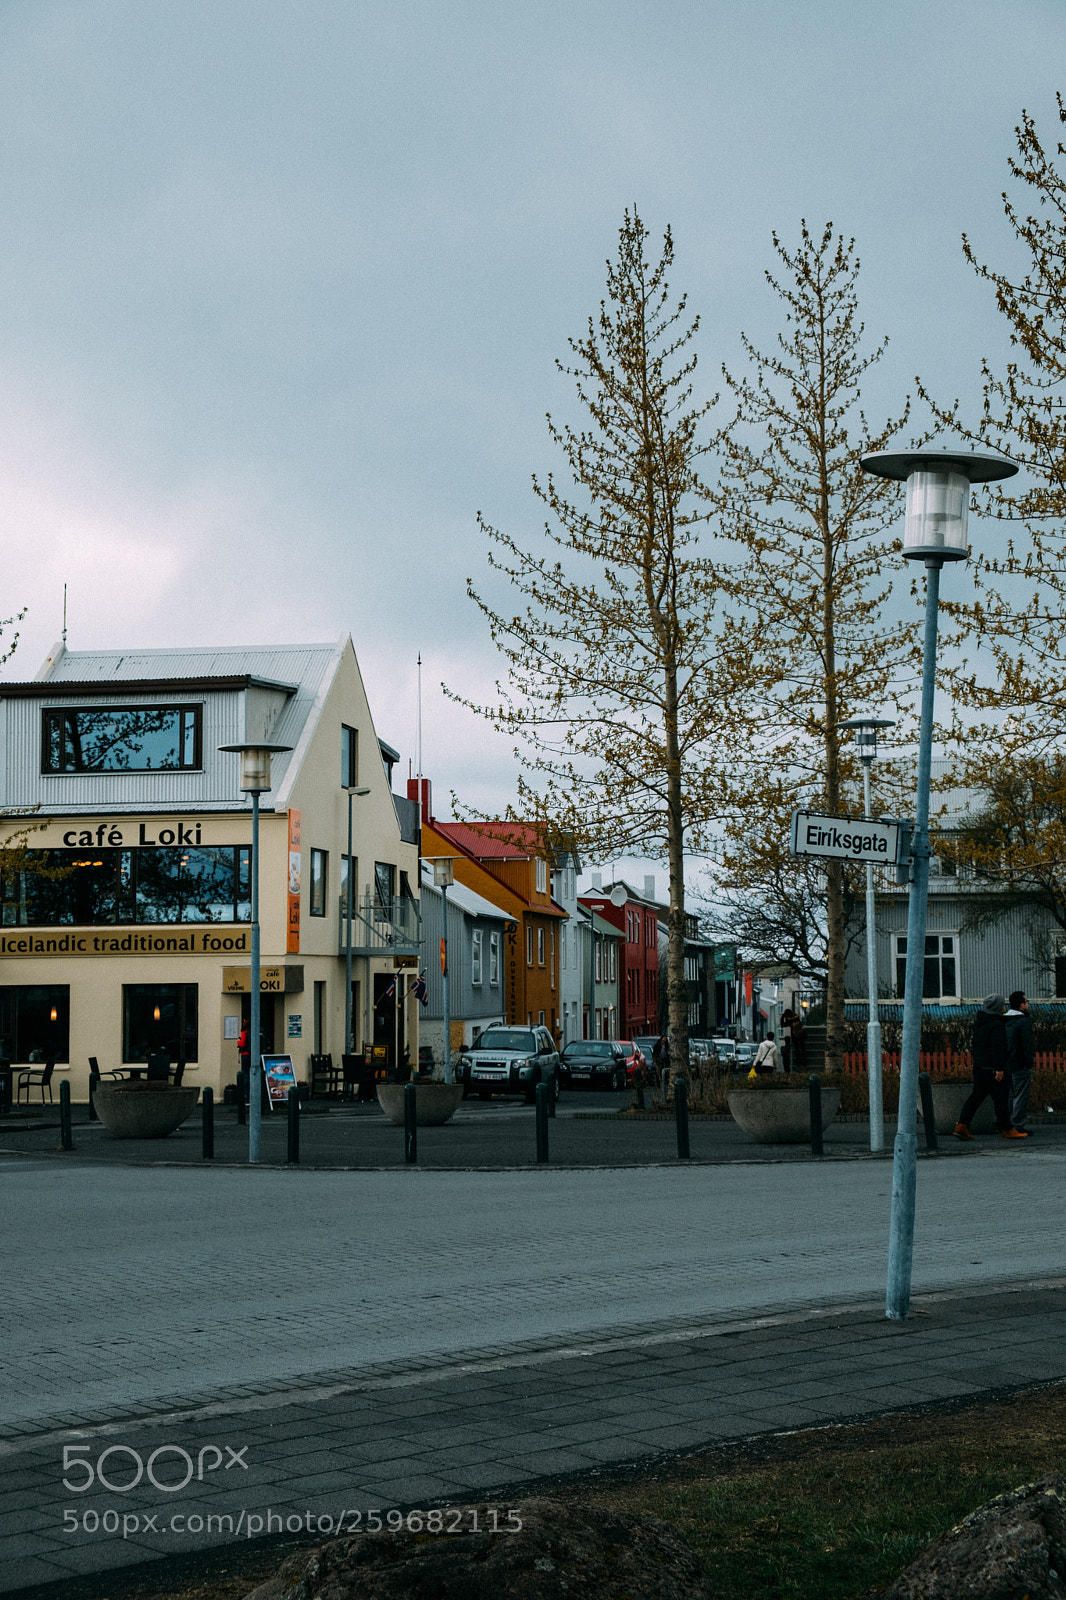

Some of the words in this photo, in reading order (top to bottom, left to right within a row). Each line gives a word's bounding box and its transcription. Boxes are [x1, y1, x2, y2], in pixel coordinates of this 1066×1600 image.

[63, 823, 123, 847] café
[139, 823, 202, 845] Loki
[806, 825, 888, 854] Eiríksgata
[1, 935, 86, 952] Icelandic
[93, 934, 195, 951] traditional
[202, 933, 246, 950] food
[508, 923, 517, 956] OKI
[260, 980, 280, 990] OKI
